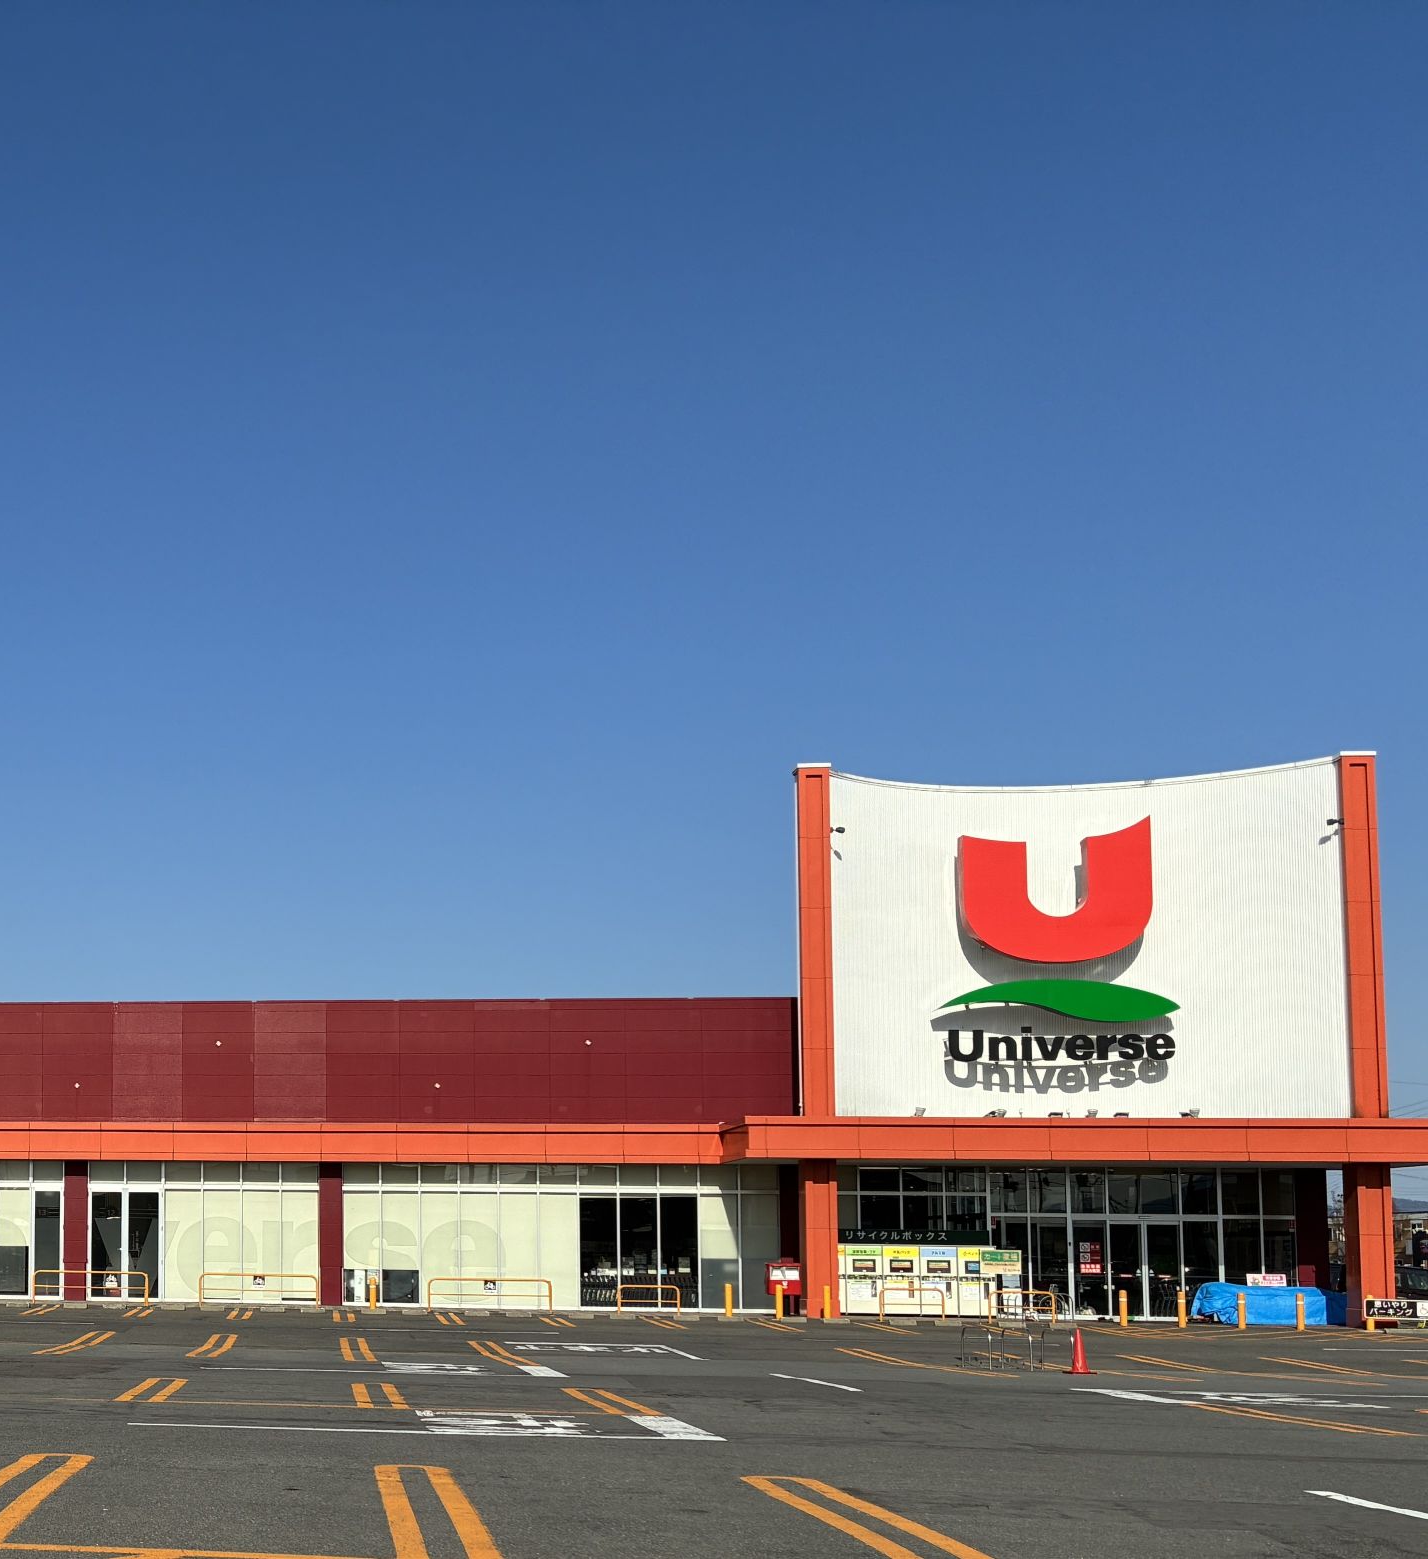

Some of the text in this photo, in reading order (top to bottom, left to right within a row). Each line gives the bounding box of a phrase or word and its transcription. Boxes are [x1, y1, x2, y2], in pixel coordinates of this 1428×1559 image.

[948, 1027, 1176, 1063] Universe
[845, 1230, 948, 1241] リサイクルボックス
[1369, 1308, 1413, 1316] パーキング
